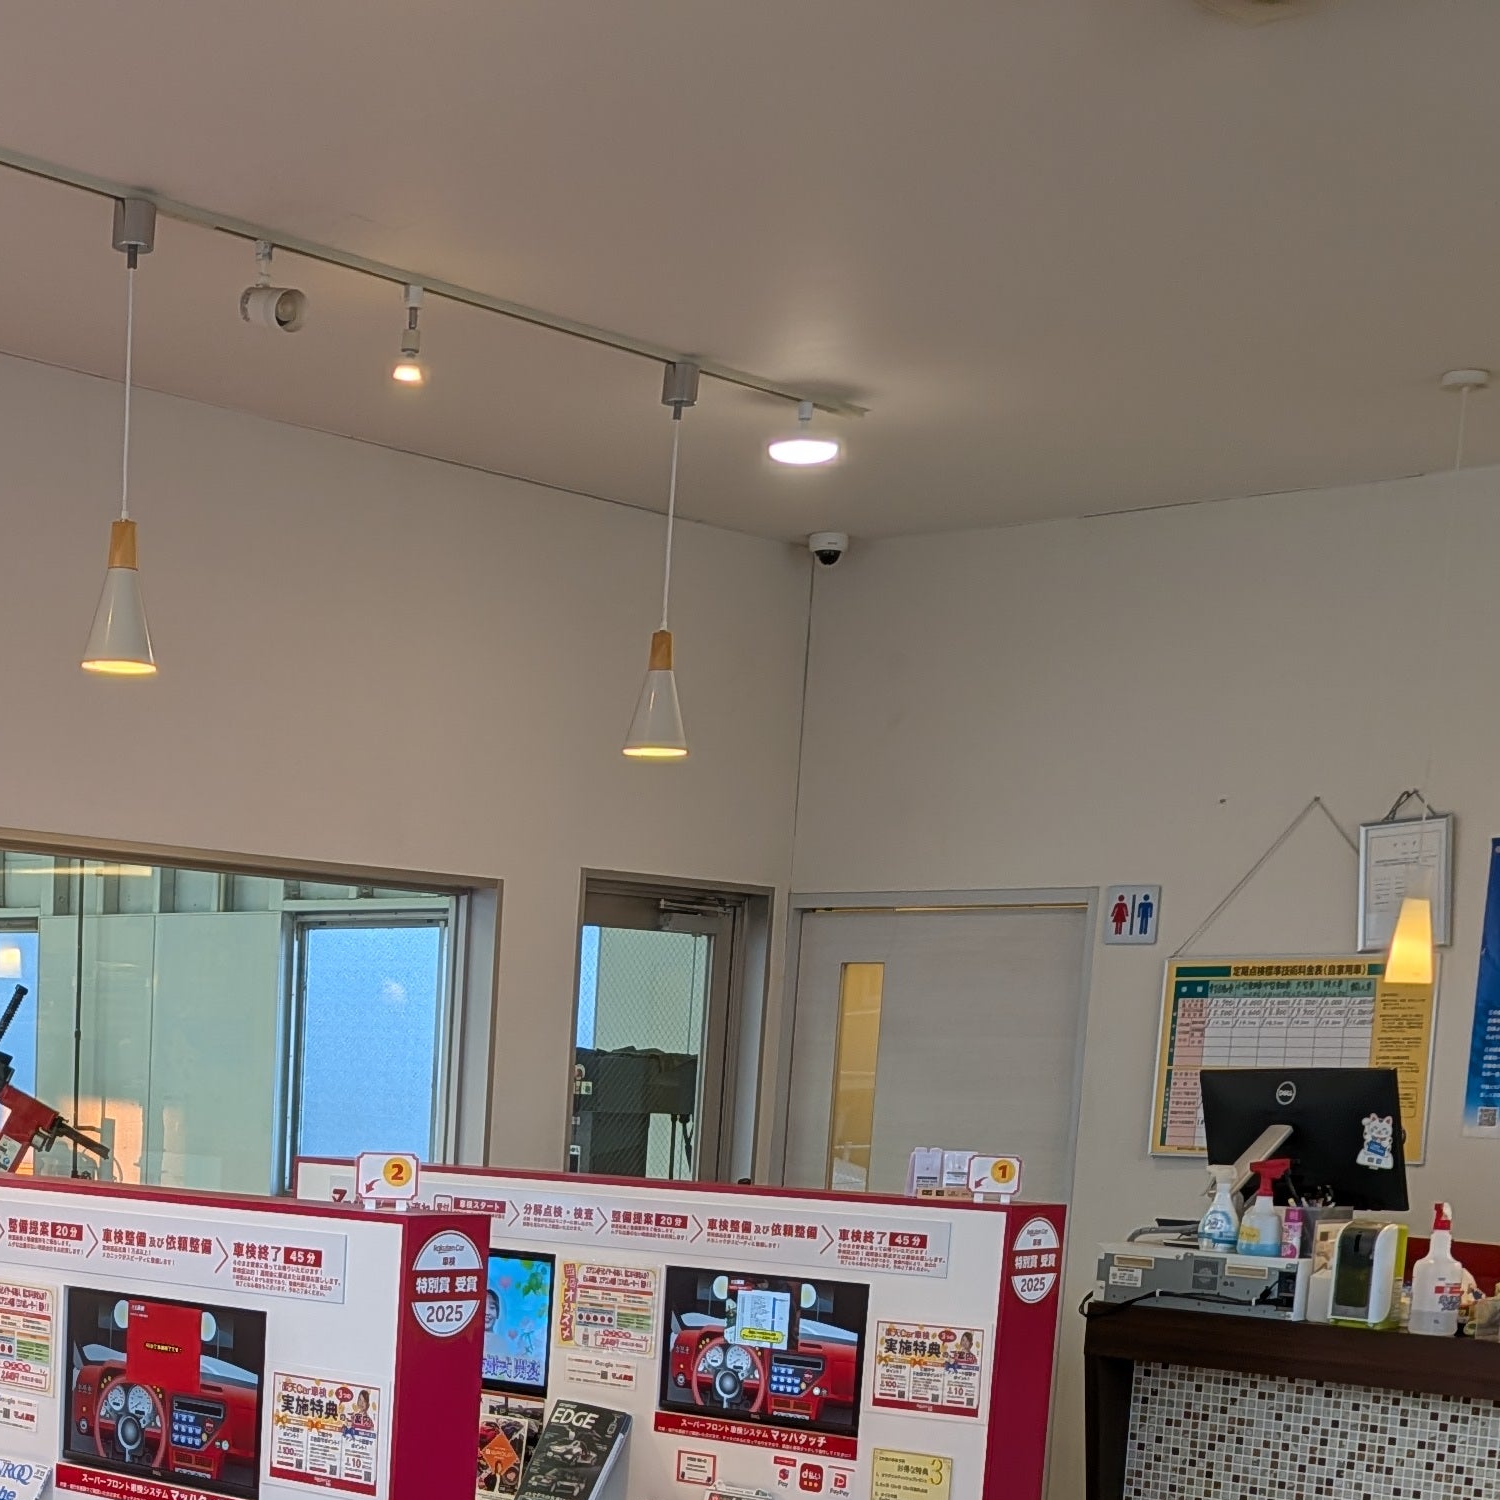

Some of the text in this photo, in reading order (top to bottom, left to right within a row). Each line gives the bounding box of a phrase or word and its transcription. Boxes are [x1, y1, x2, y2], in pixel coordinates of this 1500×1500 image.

[391, 1164, 404, 1181] 2
[998, 1165, 1007, 1178] 1
[523, 1203, 594, 1221] 分解点検・検査
[611, 1210, 683, 1227] 整備提案 20分
[8, 1217, 78, 1238] 整備提案 20分
[839, 1228, 921, 1247] 車検終了 45分
[233, 1241, 315, 1264] 車検終了 45分
[416, 1276, 477, 1294] 特別賞 受賞
[1020, 1277, 1045, 1292] 2025
[426, 1305, 463, 1323] 2025
[884, 1338, 941, 1358] 実施特典
[281, 1394, 338, 1420] 実施特典
[551, 1408, 599, 1429] EDGE
[770, 1429, 827, 1447] マッハタッチ
[930, 1459, 943, 1485] 3
